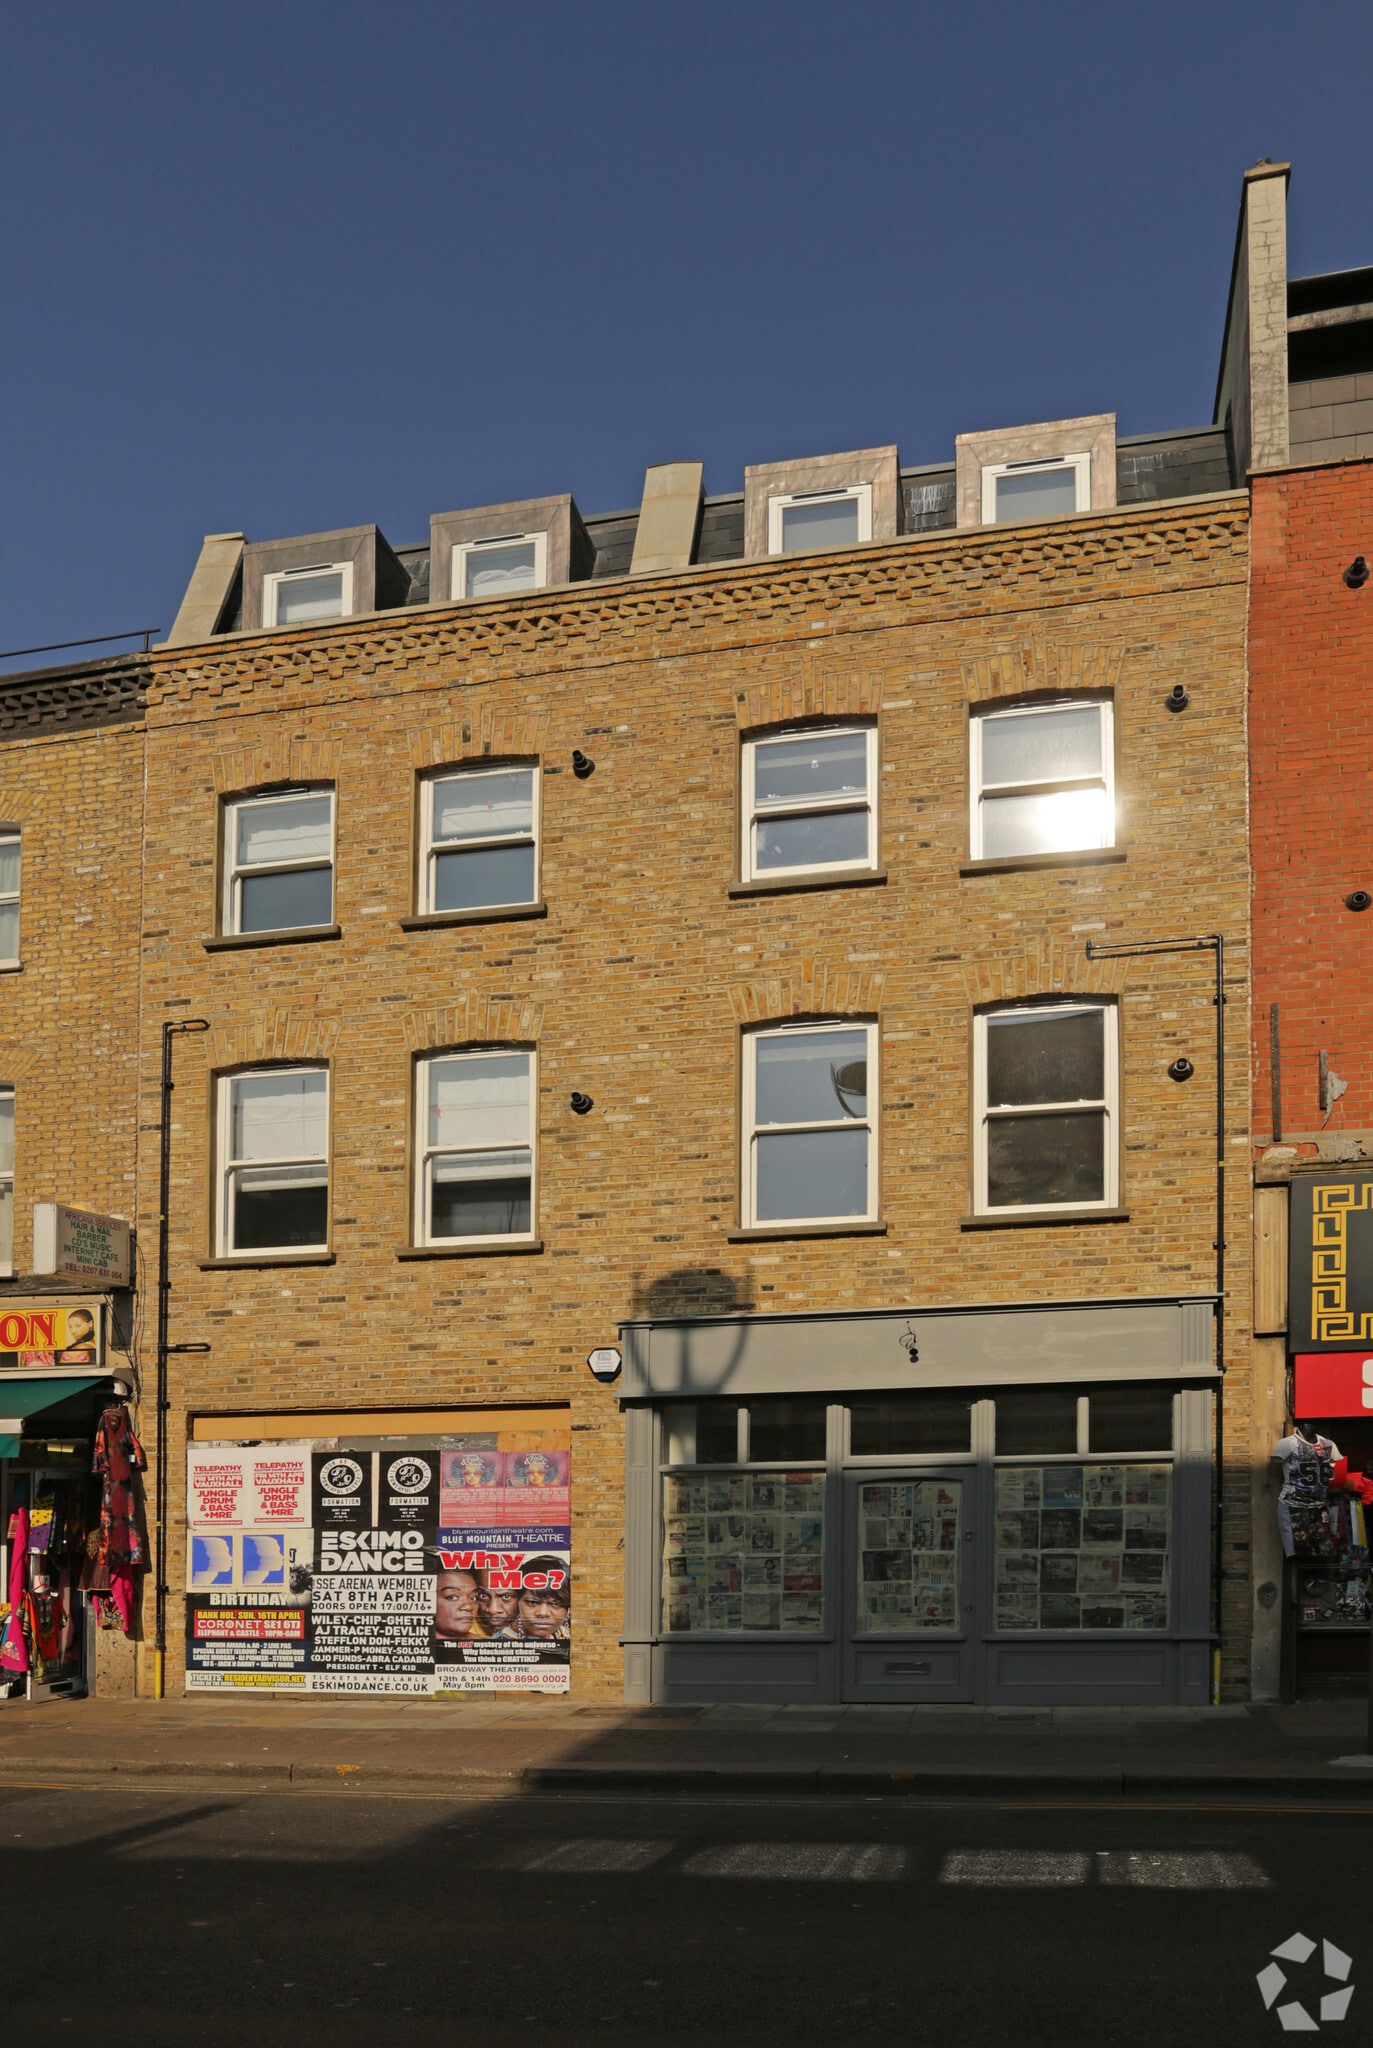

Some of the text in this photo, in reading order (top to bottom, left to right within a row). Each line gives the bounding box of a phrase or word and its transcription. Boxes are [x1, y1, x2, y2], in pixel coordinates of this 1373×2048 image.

[65, 1211, 121, 1231] AFRICANA SERVICES
[70, 1220, 88, 1231] HAIR
[97, 1227, 112, 1236] NAIL
[77, 1230, 107, 1243] BARBER
[90, 1242, 111, 1252] MUSIC
[64, 1244, 119, 1262] INTERNET CAFE
[76, 1255, 108, 1268] MINI CAB
[82, 1265, 97, 1274] 0207
[322, 1530, 424, 1550] ESKIMO
[442, 1534, 564, 1544] BLUE MOUNTAIN THEATRE
[321, 1551, 424, 1572] DANCE
[316, 1578, 336, 1590] SSE
[338, 1578, 374, 1590] ARENA
[378, 1578, 433, 1590] WEMBLEY
[490, 1570, 565, 1589] Me?
[210, 1593, 288, 1605] BIRTHDAY
[313, 1591, 431, 1602] SAT 8TH APRIL
[381, 1603, 432, 1611] 17:00/16+
[278, 1612, 301, 1620] APRIL
[312, 1615, 434, 1625] WILEY-CHIP-GHETTS
[197, 1620, 262, 1629] CORONET
[264, 1620, 282, 1629] SE1
[315, 1626, 429, 1636] AJ TRACEY-DEVLIN
[314, 1636, 430, 1646] STEFFLON DON-FEKKY
[224, 1674, 305, 1682] RESIDENTADVISOR.NET
[312, 1682, 429, 1692] ESKIMODANCE.CO.UK
